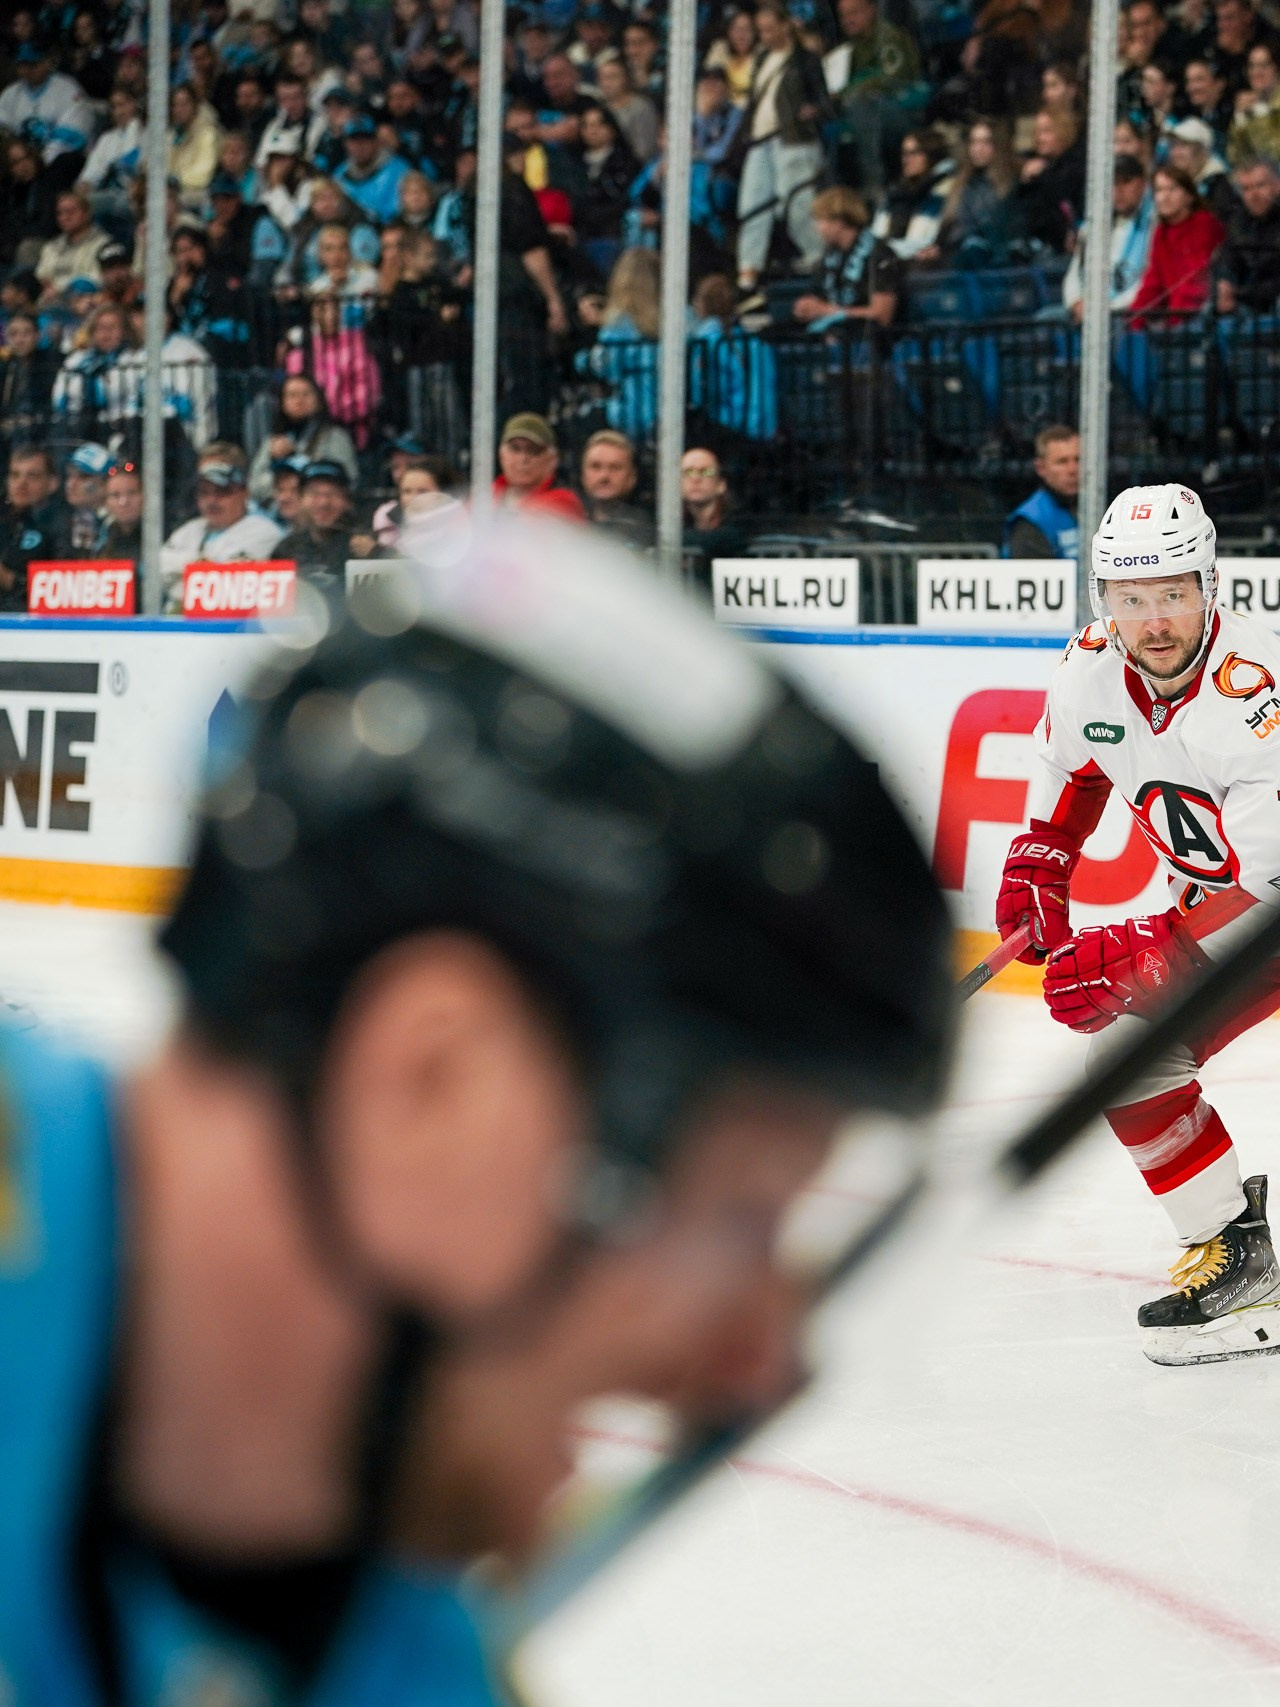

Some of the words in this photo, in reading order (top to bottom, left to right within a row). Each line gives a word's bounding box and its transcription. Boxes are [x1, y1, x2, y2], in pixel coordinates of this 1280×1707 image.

[1130, 503, 1153, 521] 15
[1113, 554, 1160, 567] согаз
[29, 569, 132, 610] FONBET
[184, 570, 295, 611] FONBET
[723, 577, 846, 608] KHL.RU
[930, 579, 1064, 612] KHL.RU
